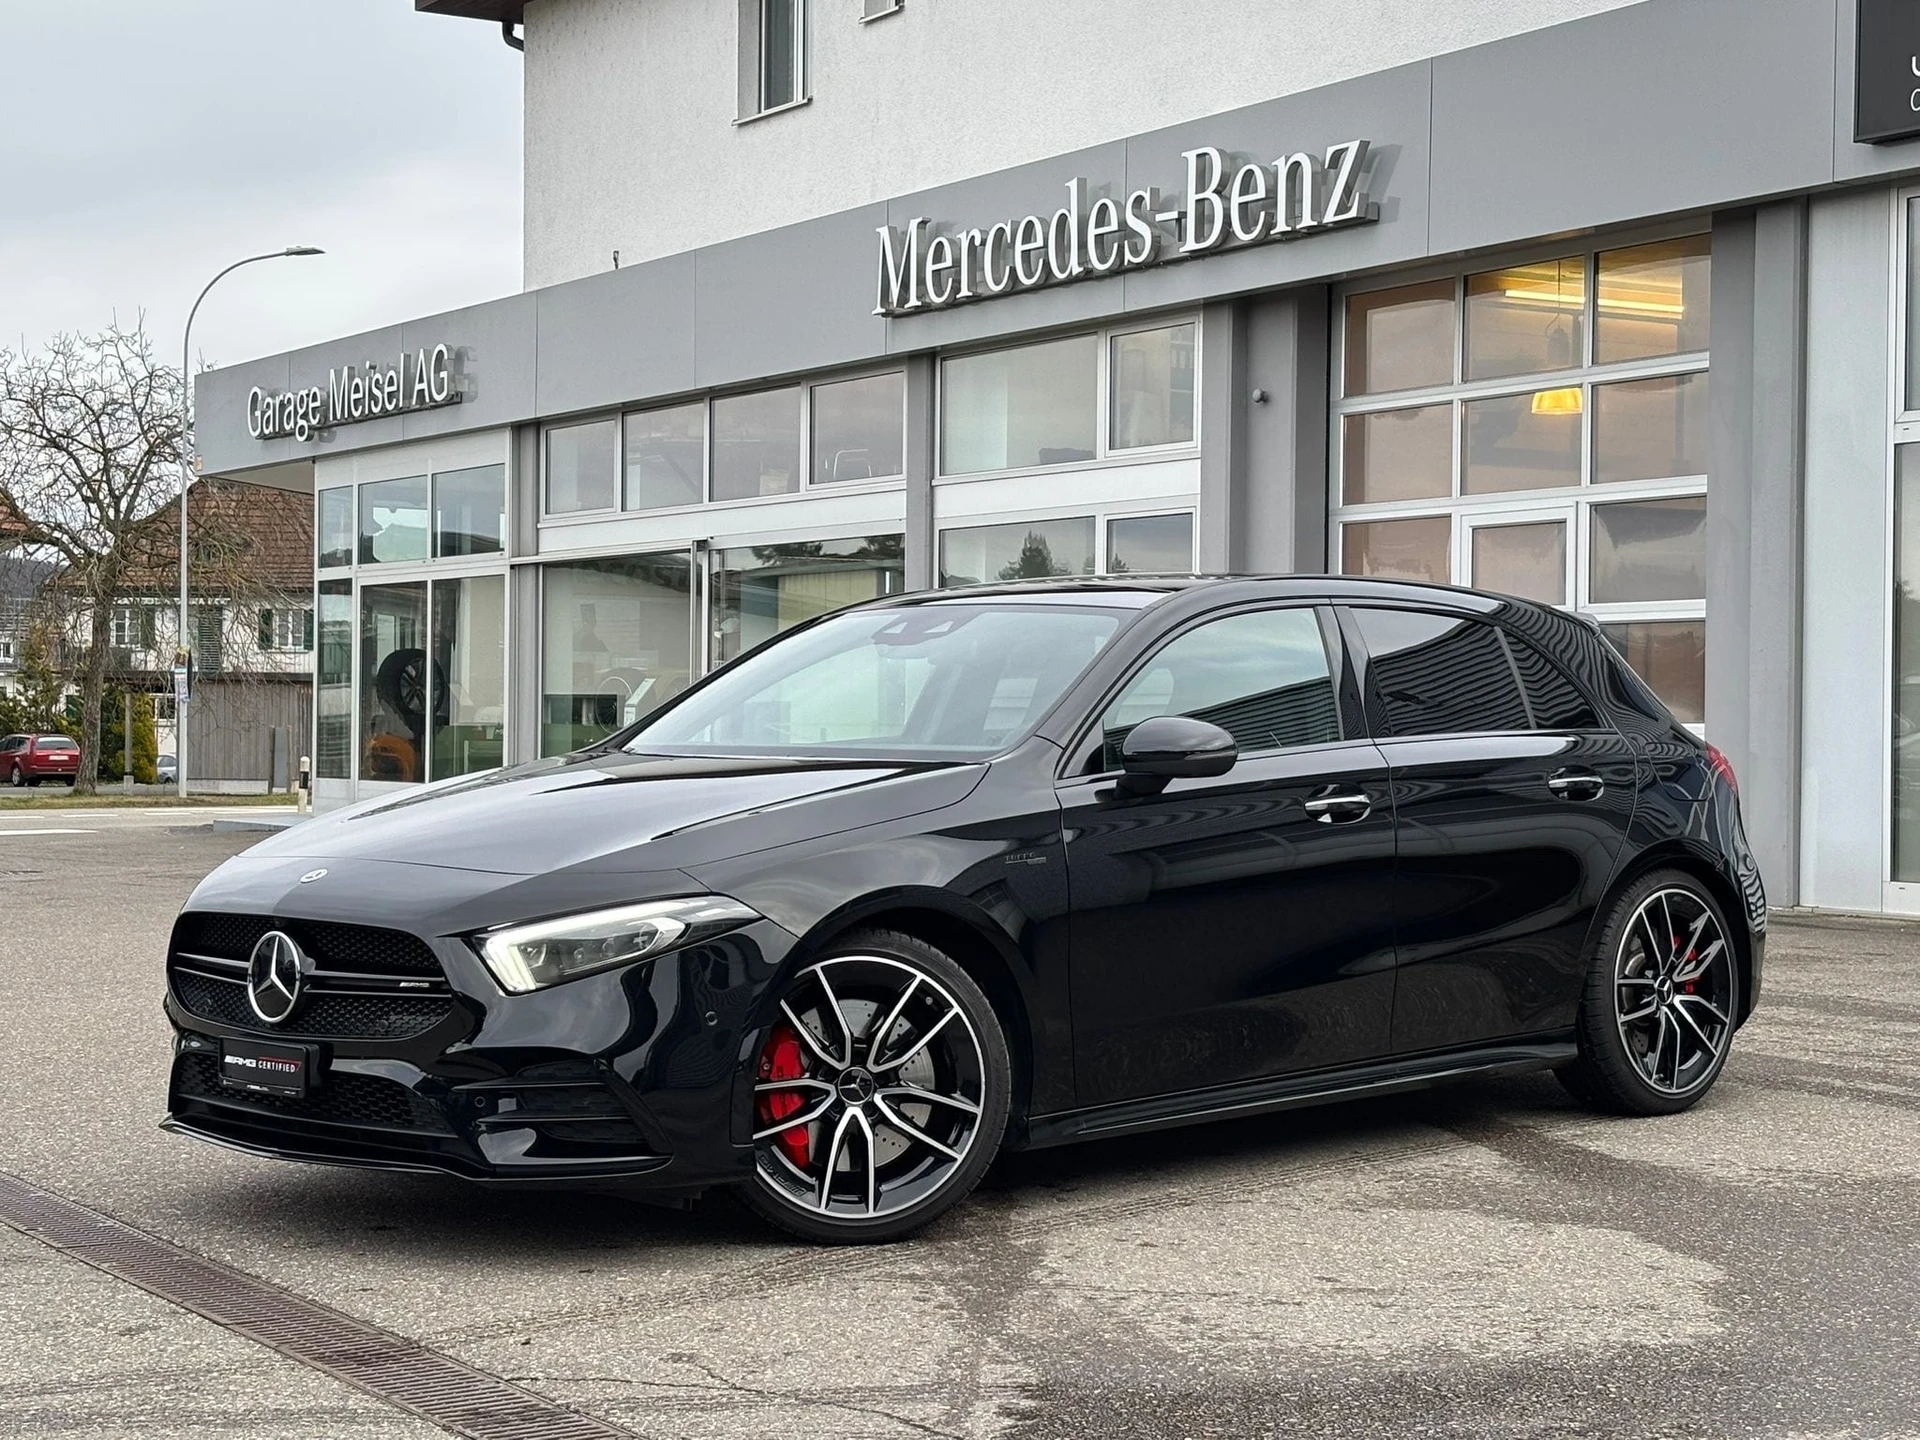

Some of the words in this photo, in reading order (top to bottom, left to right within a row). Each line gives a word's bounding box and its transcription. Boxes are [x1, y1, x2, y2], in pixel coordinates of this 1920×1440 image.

[871, 139, 1372, 317] Mercedes-Benz
[246, 385, 322, 443] Garage
[328, 352, 405, 422] Meisel
[412, 343, 449, 406] AG
[258, 1060, 297, 1073] CERTIFIED
